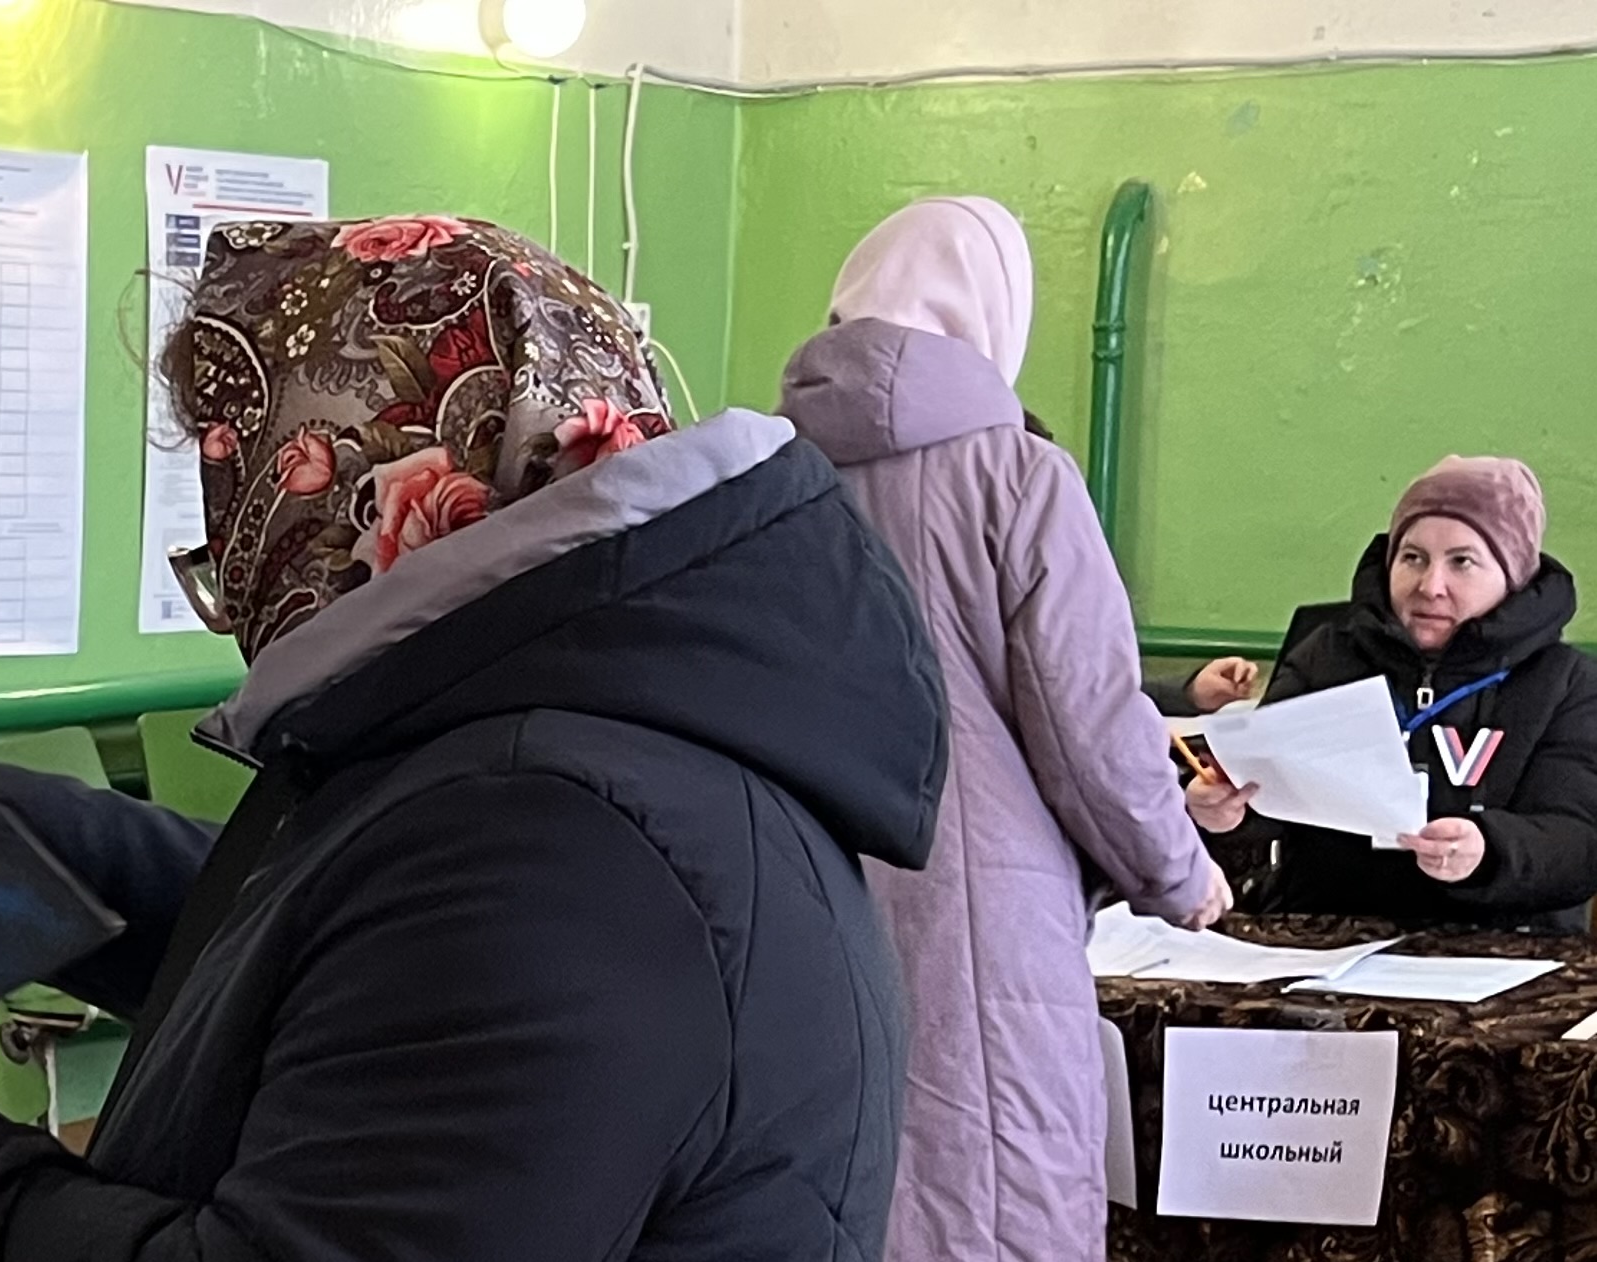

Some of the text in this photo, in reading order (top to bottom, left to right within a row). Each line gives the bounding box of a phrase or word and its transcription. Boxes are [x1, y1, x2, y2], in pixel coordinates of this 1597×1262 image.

[1431, 724, 1505, 787] V
[1208, 1093, 1360, 1119] центральная
[1220, 1140, 1343, 1163] школьный
